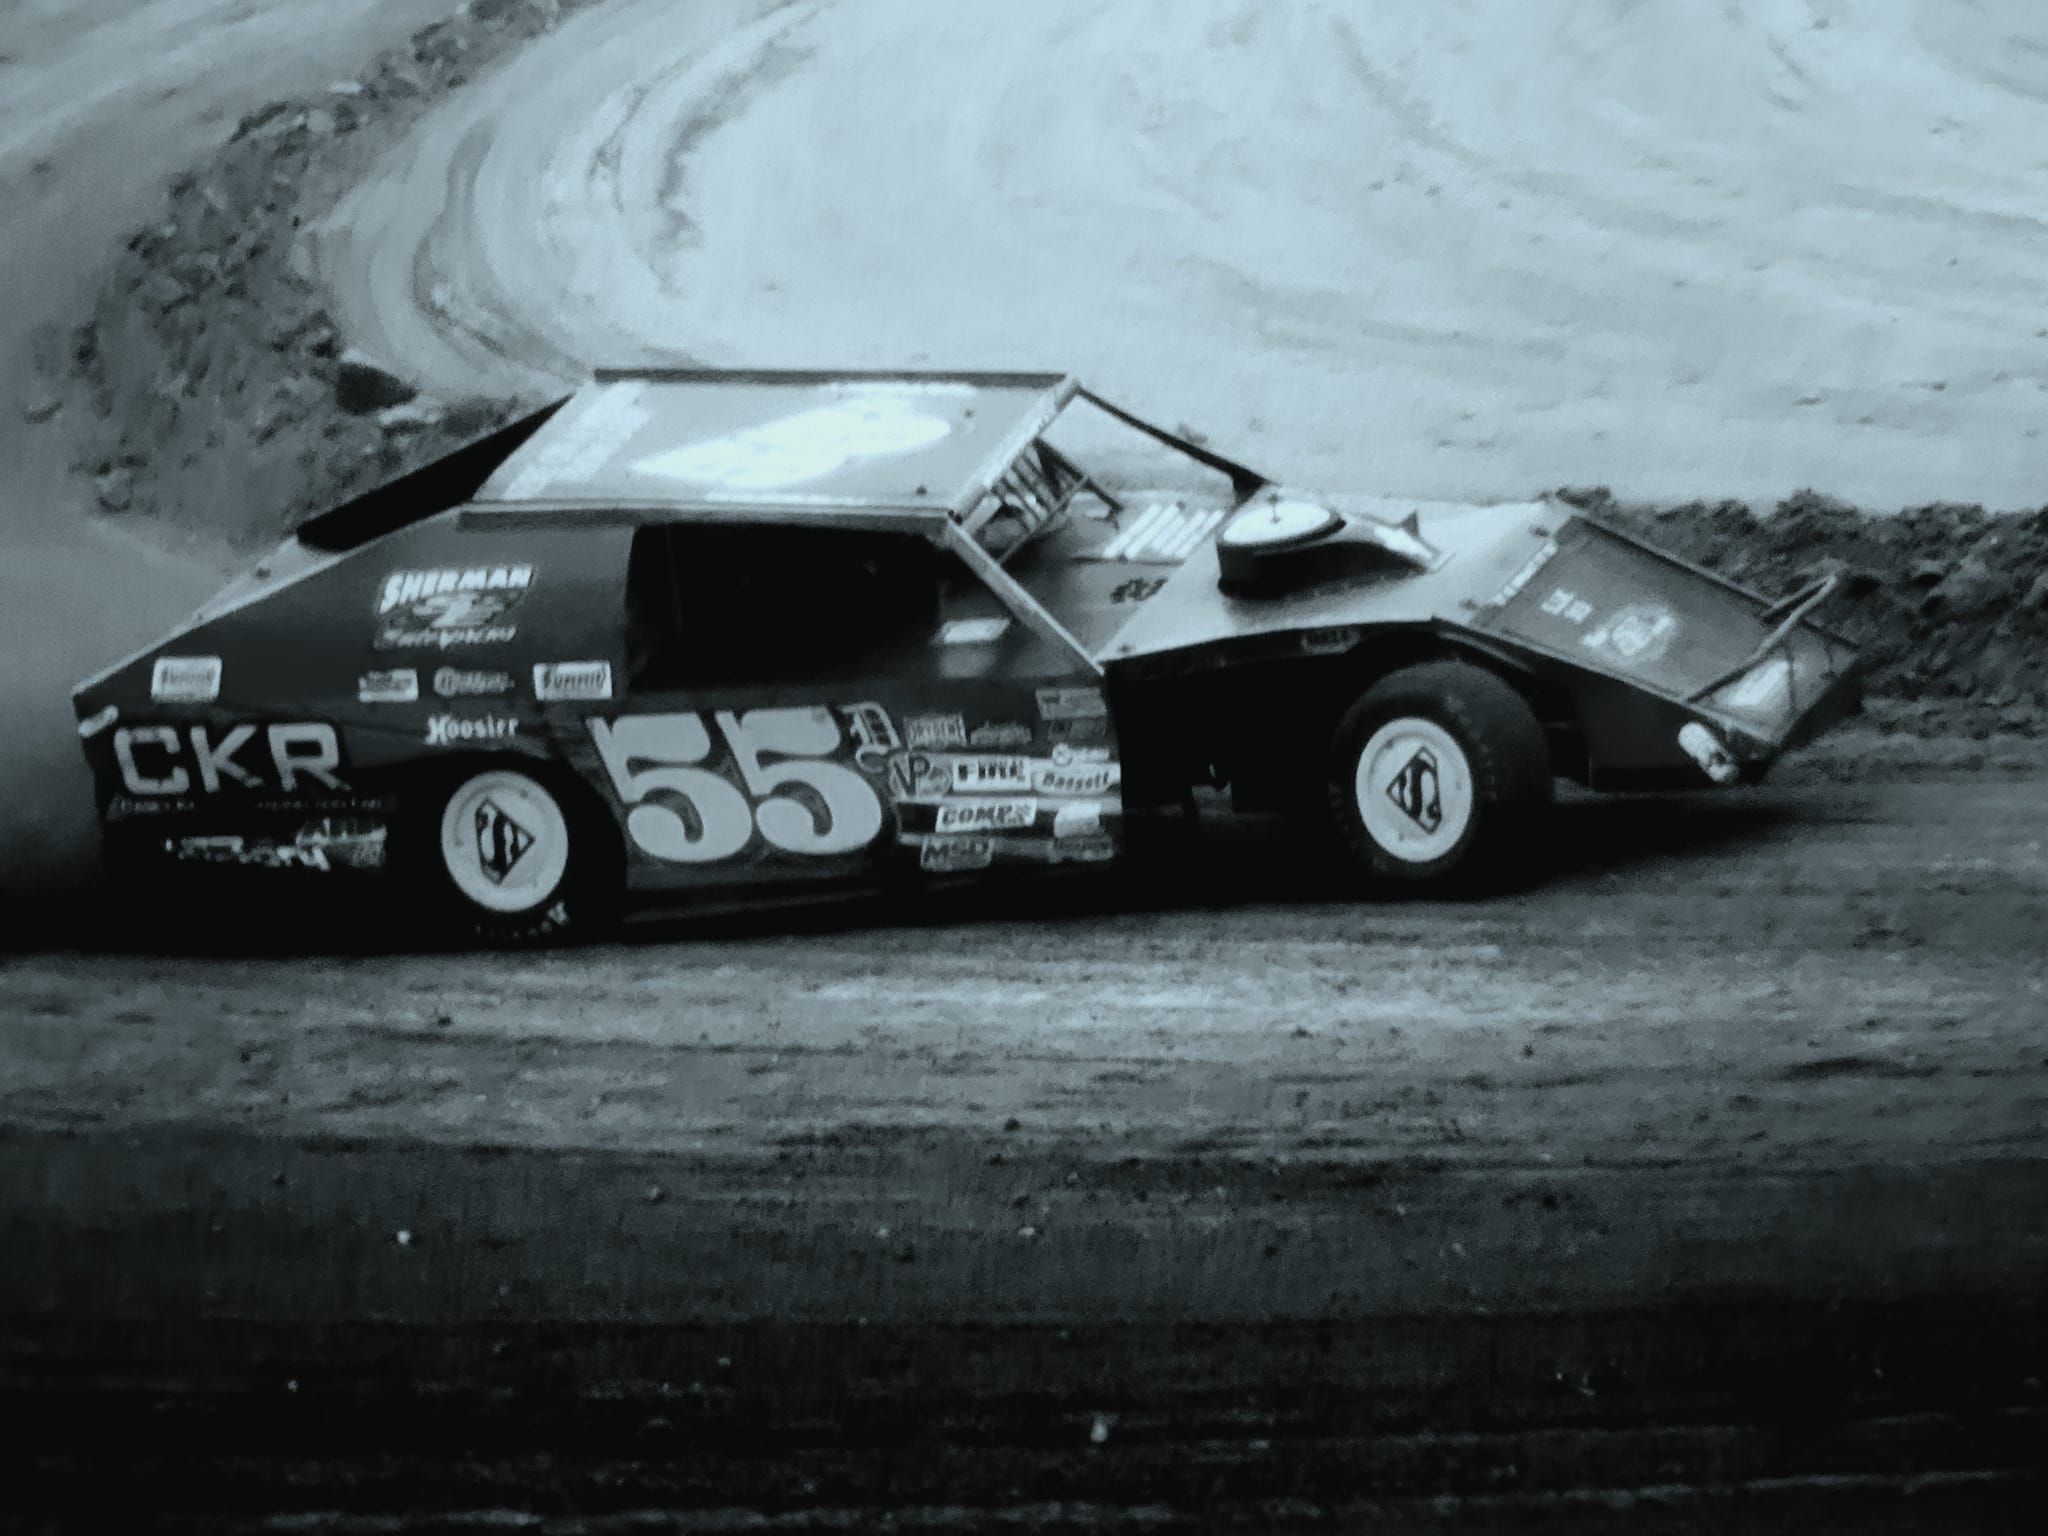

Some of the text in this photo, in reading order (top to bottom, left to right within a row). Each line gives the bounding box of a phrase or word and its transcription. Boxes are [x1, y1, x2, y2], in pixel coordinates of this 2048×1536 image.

[379, 563, 533, 614] SHERMAN
[113, 721, 352, 796] CKR
[424, 713, 519, 745] Hoosier
[586, 704, 882, 864] 55
